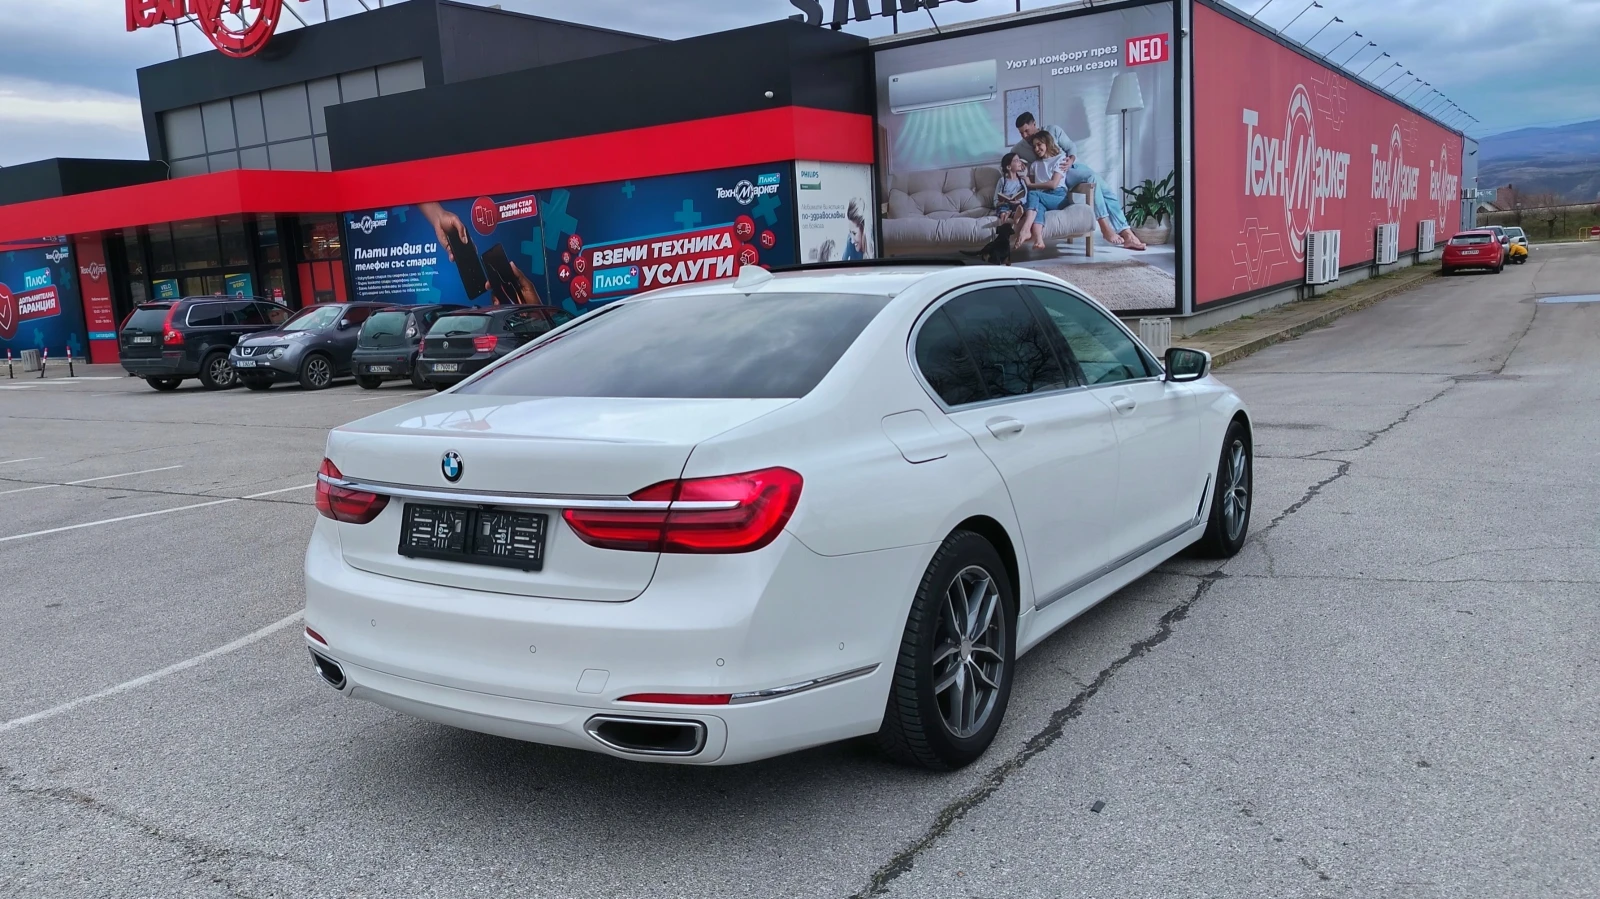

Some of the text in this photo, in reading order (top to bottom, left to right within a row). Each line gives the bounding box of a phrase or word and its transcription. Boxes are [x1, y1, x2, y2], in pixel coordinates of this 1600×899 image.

[1006, 45, 1118, 70] Уют и комфорт през
[1128, 38, 1162, 64] NEO
[1051, 58, 1118, 76] всеки сезон
[354, 242, 437, 260] Плати новия си
[592, 232, 733, 267] ВЗЕМИ ТЕХНИКА
[355, 257, 437, 272] телефон със стария
[642, 254, 735, 287] УСЛУГИ
[18, 298, 56, 315] ГАРАНЦИЯ
